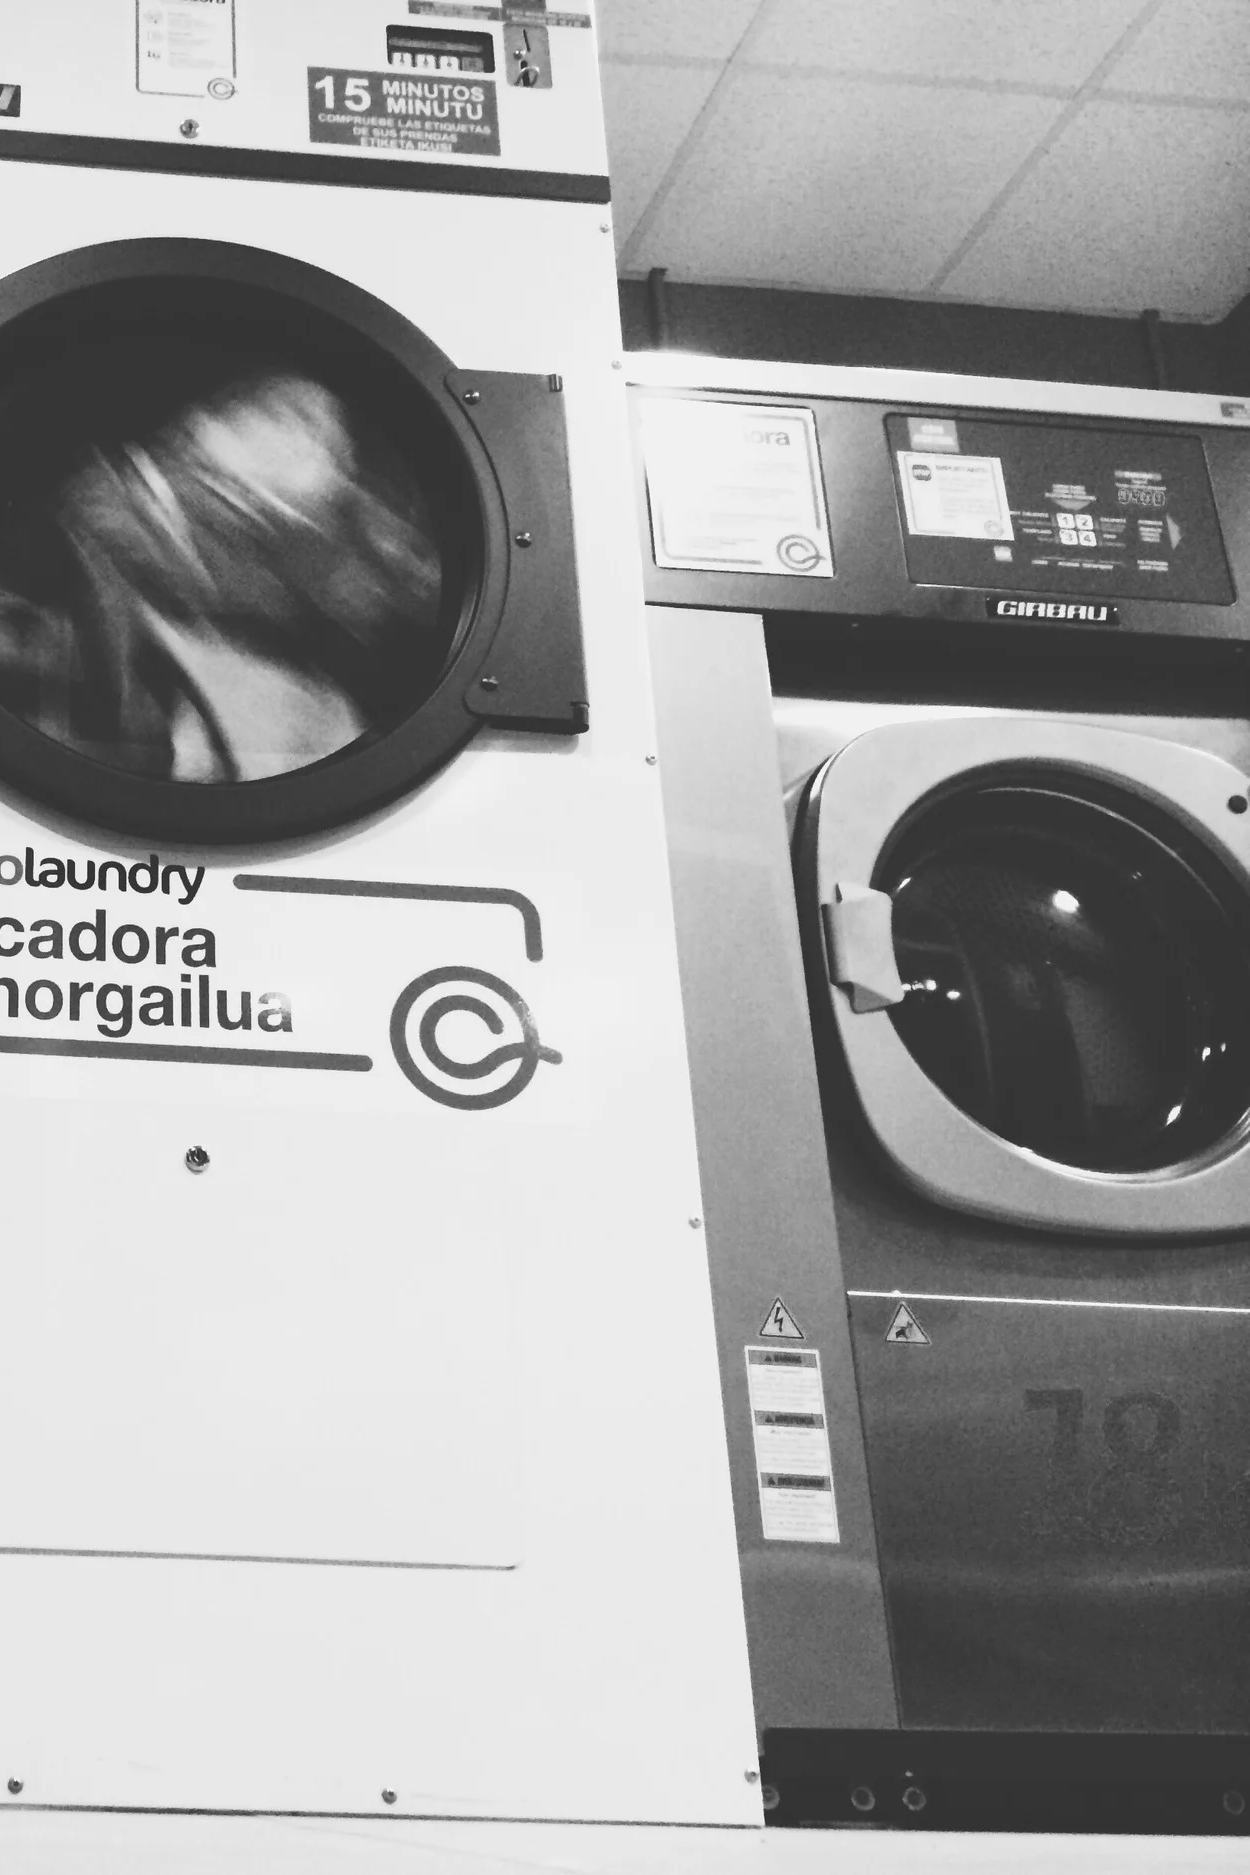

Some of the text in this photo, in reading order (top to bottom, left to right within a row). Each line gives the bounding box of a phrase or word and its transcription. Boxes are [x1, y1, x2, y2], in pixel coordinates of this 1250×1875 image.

[314, 75, 372, 112] 15
[382, 79, 485, 102] MINUTOS
[386, 97, 484, 120] MINUTU
[317, 112, 491, 135] COMPRUEBE LAS ETIQUETAS
[352, 126, 458, 143] DE SUS PRENDAS
[360, 137, 415, 151] ETIKETA
[996, 600, 1108, 621] GIRBAU
